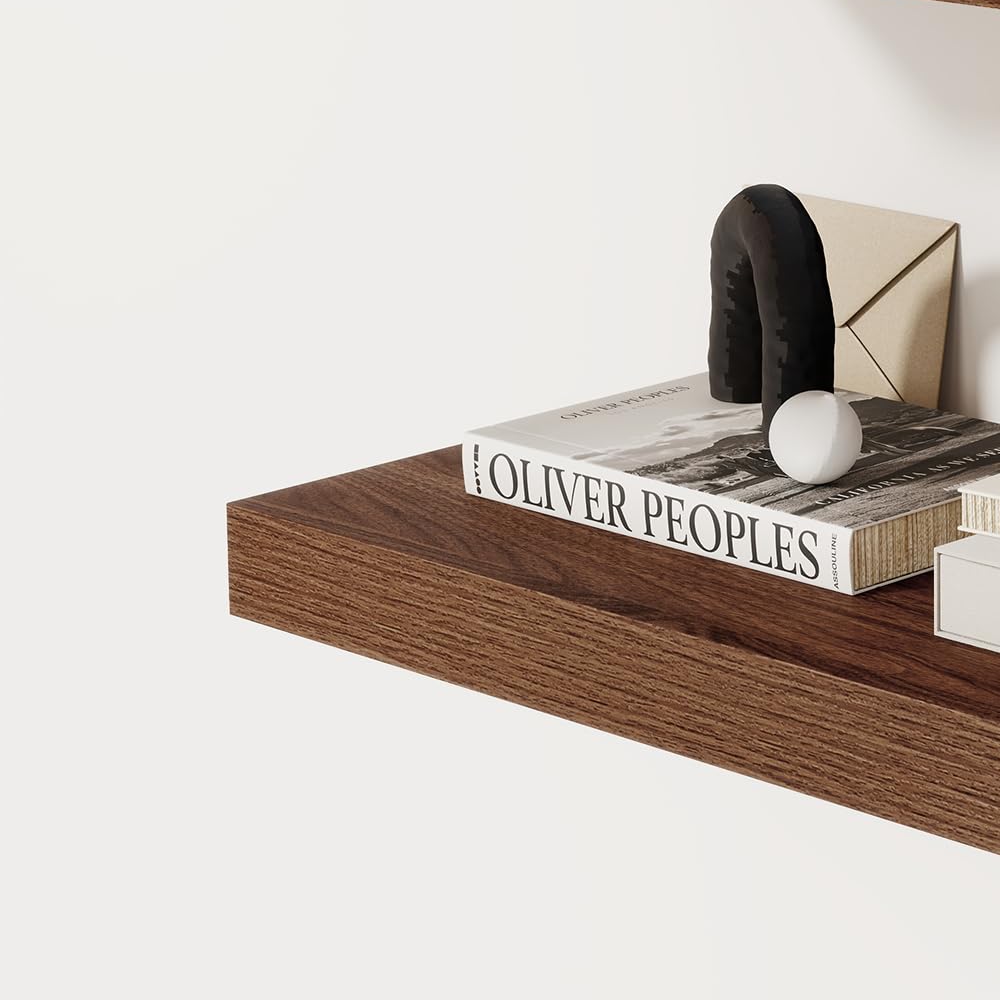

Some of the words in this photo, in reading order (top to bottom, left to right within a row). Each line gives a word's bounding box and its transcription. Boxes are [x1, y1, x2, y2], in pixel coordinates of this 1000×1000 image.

[560, 402, 622, 420] OLIVER
[620, 385, 691, 405] PEOPLES
[488, 453, 632, 533] OLIVER
[641, 489, 820, 580] PEOPLES
[831, 533, 839, 590] ASSOULINE
